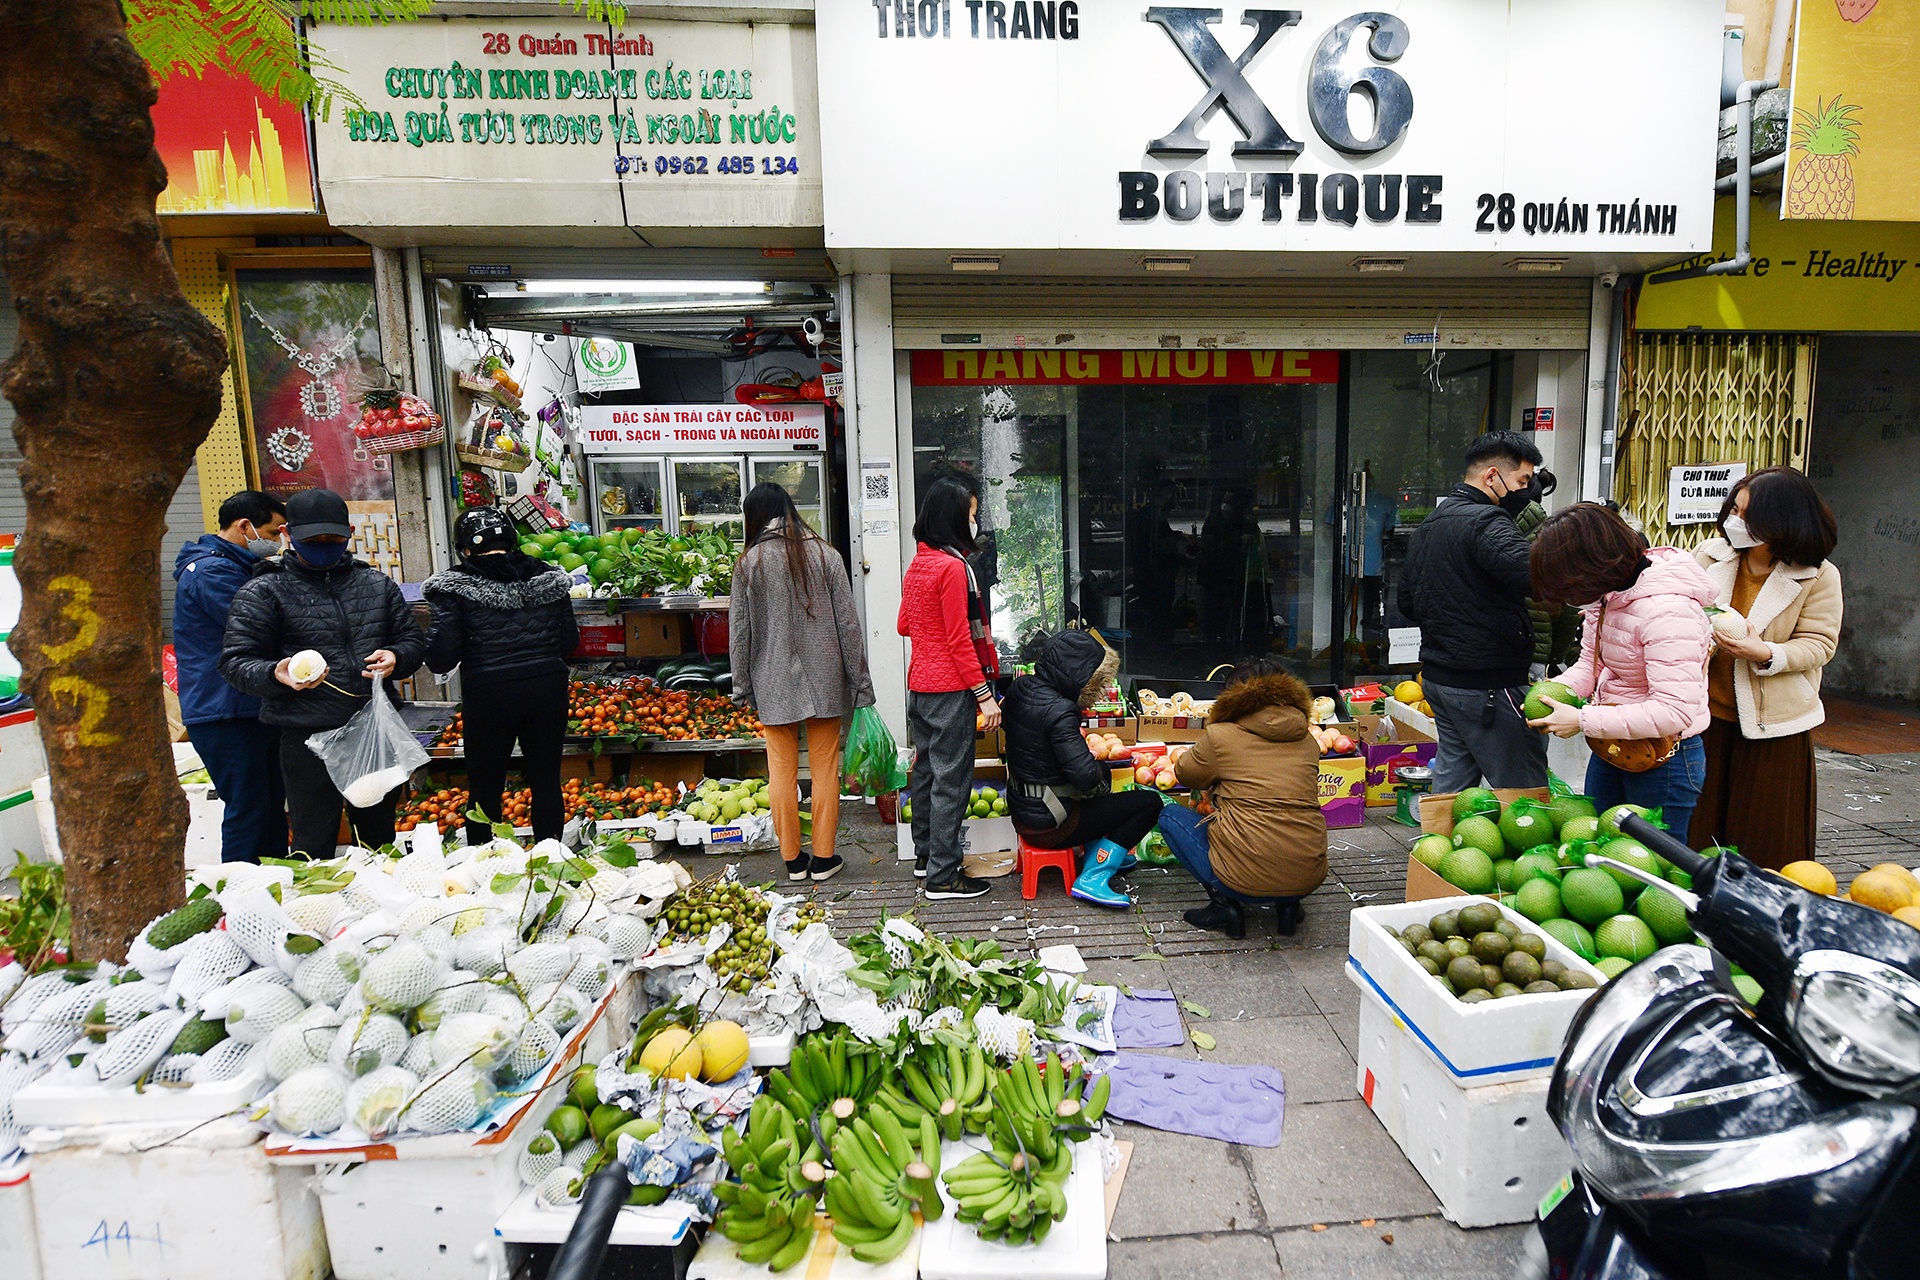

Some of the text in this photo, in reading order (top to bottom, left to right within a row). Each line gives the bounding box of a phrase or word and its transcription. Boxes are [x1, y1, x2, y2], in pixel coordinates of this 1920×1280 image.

[965, 0, 1080, 40] TRANG
[482, 32, 654, 57] 28 Quán Thánh
[385, 60, 753, 109] CHUYÊN KINH DOANH CÁC LOẠI
[1141, 6, 1414, 155] X6
[349, 101, 796, 147] HOA QUẢ TƯƠI TRONG VÀ NGOÀI NƯỚC
[614, 155, 799, 176] ĐT: 0962 485 134
[1117, 170, 1443, 229] BOUTIQUE
[1475, 193, 1678, 235] 28 QUÁN THÁNH
[1803, 250, 1908, 283] Healthy
[613, 407, 795, 426] ĐẶC SẢN TRÁI CÂY CÁC LOẠI
[588, 429, 622, 442] TƯƠI,
[626, 430, 661, 443] SẠCH
[673, 429, 717, 441] TRONG
[720, 427, 737, 440] VÀ
[741, 427, 780, 440] NGOÀI
[784, 425, 820, 440] NƯỚC
[1683, 468, 1731, 481] CHO THUÊ
[1680, 485, 1729, 498] CỬA HÀNG
